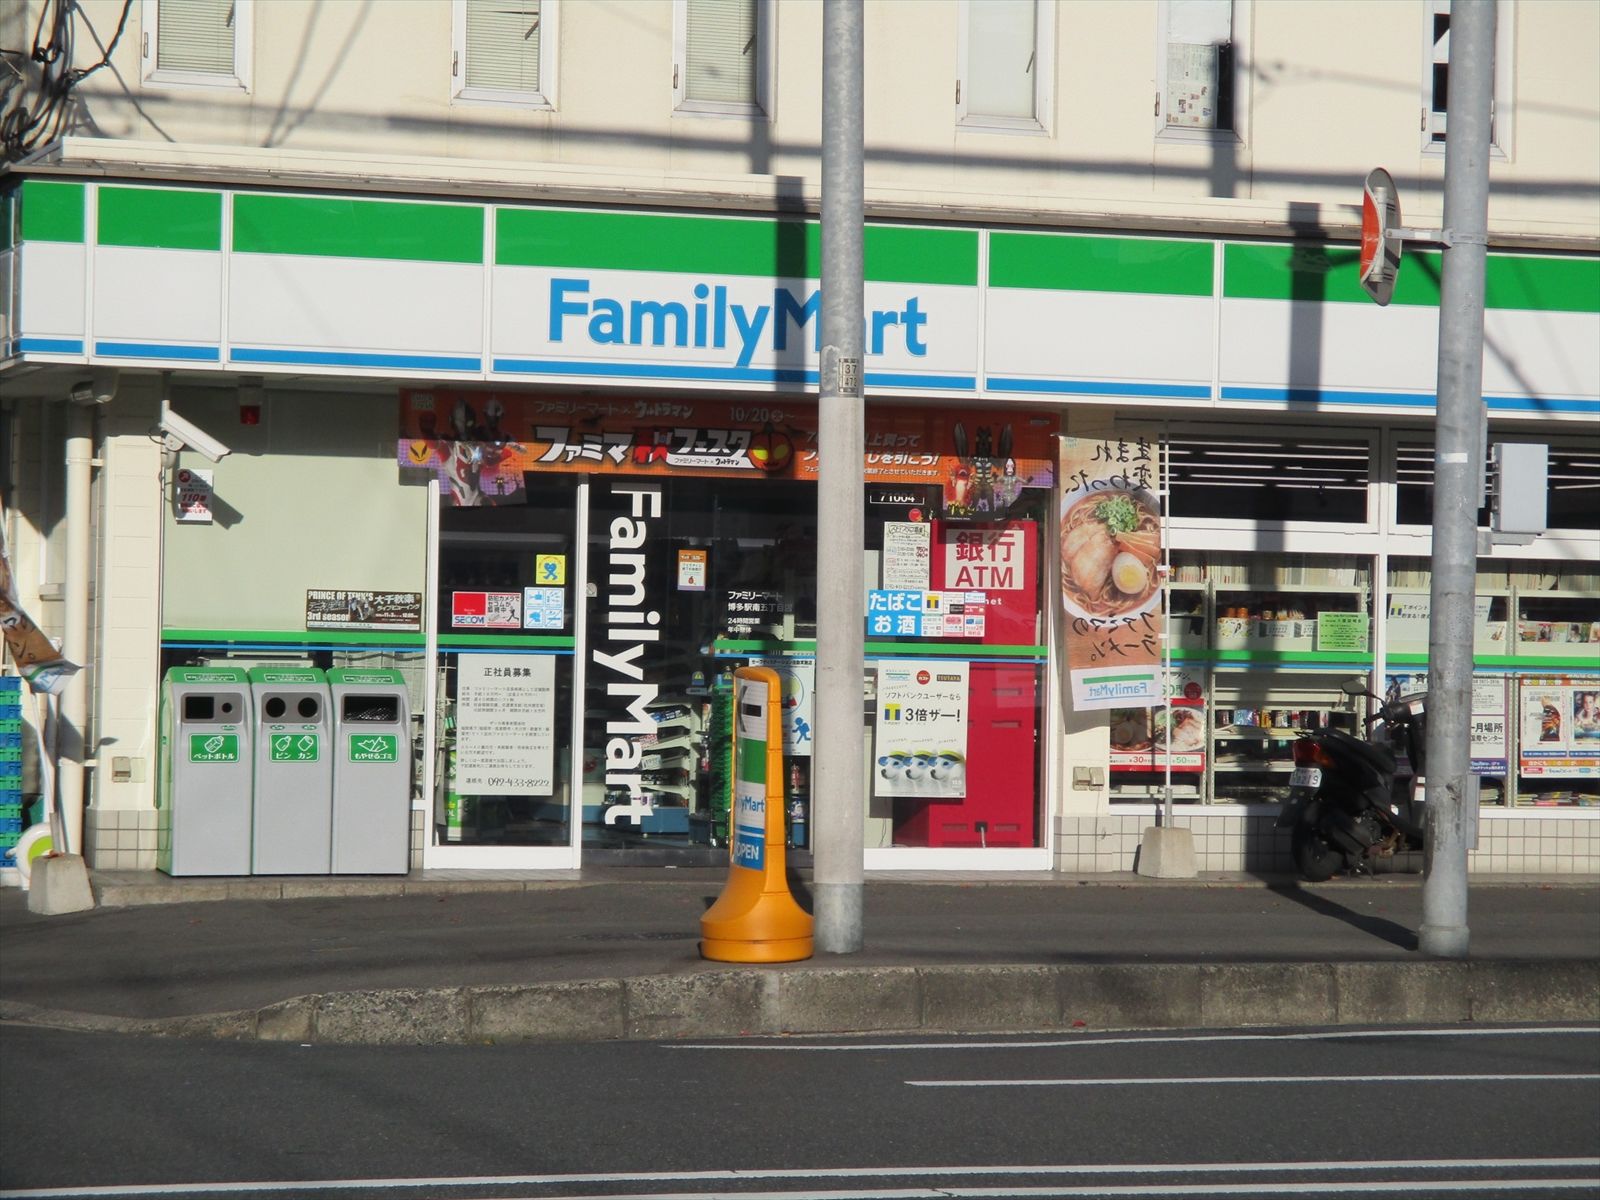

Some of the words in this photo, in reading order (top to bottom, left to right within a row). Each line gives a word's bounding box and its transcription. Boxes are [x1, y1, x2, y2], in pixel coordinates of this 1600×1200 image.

[547, 278, 928, 369] FamilyMrt
[845, 364, 857, 374] 37
[955, 531, 1016, 563] 銀行
[955, 566, 1014, 588] ATM
[728, 591, 783, 600] ファミリーマート
[870, 592, 921, 611] たばこ
[307, 611, 322, 621] 3rd
[454, 616, 485, 624] SECOM
[874, 615, 916, 635] お酒
[593, 482, 662, 825] FamilyMart
[484, 667, 532, 678] 正社員募集
[193, 752, 235, 760] ペットボトル
[275, 752, 290, 760] ビン
[298, 752, 313, 760] カン
[354, 752, 393, 760] もやせるゴミ
[736, 843, 760, 860] OPEN
